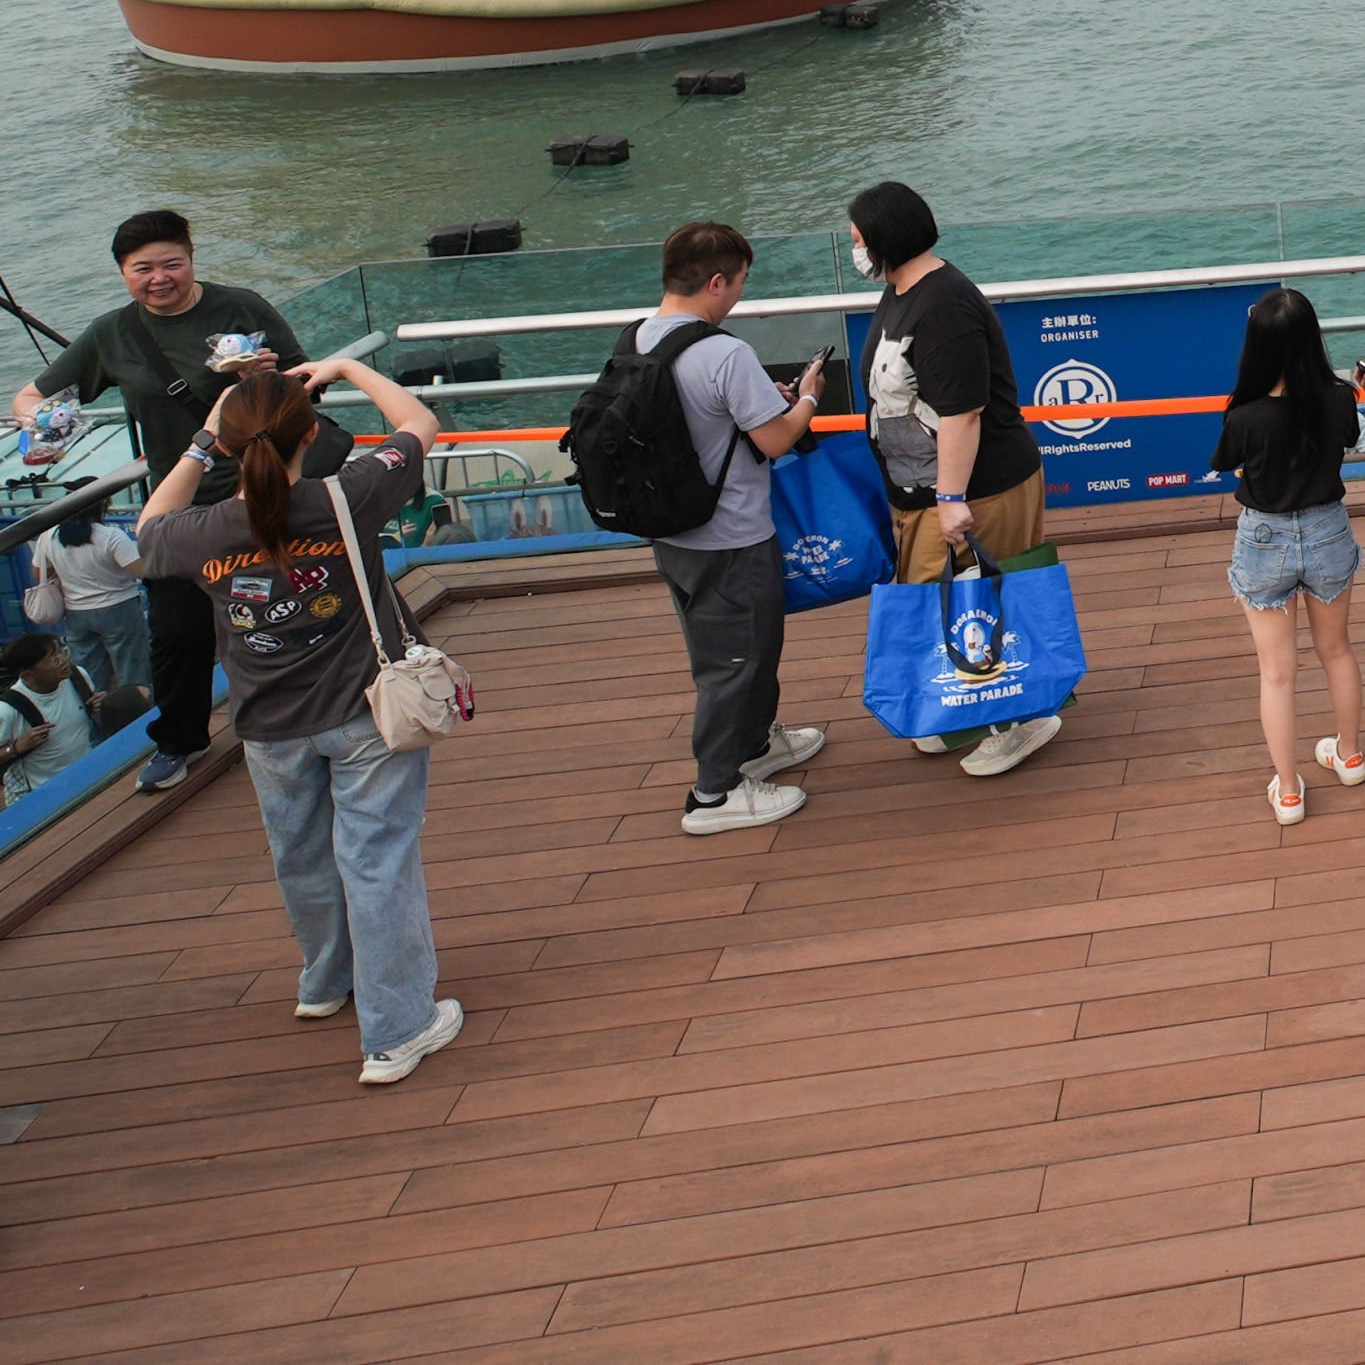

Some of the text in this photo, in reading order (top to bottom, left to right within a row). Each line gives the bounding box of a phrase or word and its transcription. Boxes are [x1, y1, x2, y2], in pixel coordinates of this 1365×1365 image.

[1041, 330, 1099, 343] ORGANISER
[1088, 478, 1131, 492] PEANUTS
[1148, 477, 1164, 486] POP
[1165, 474, 1187, 485] MART
[202, 538, 348, 584] Diretion
[269, 600, 297, 620] ASP
[941, 683, 1024, 707] WATER PARADE
